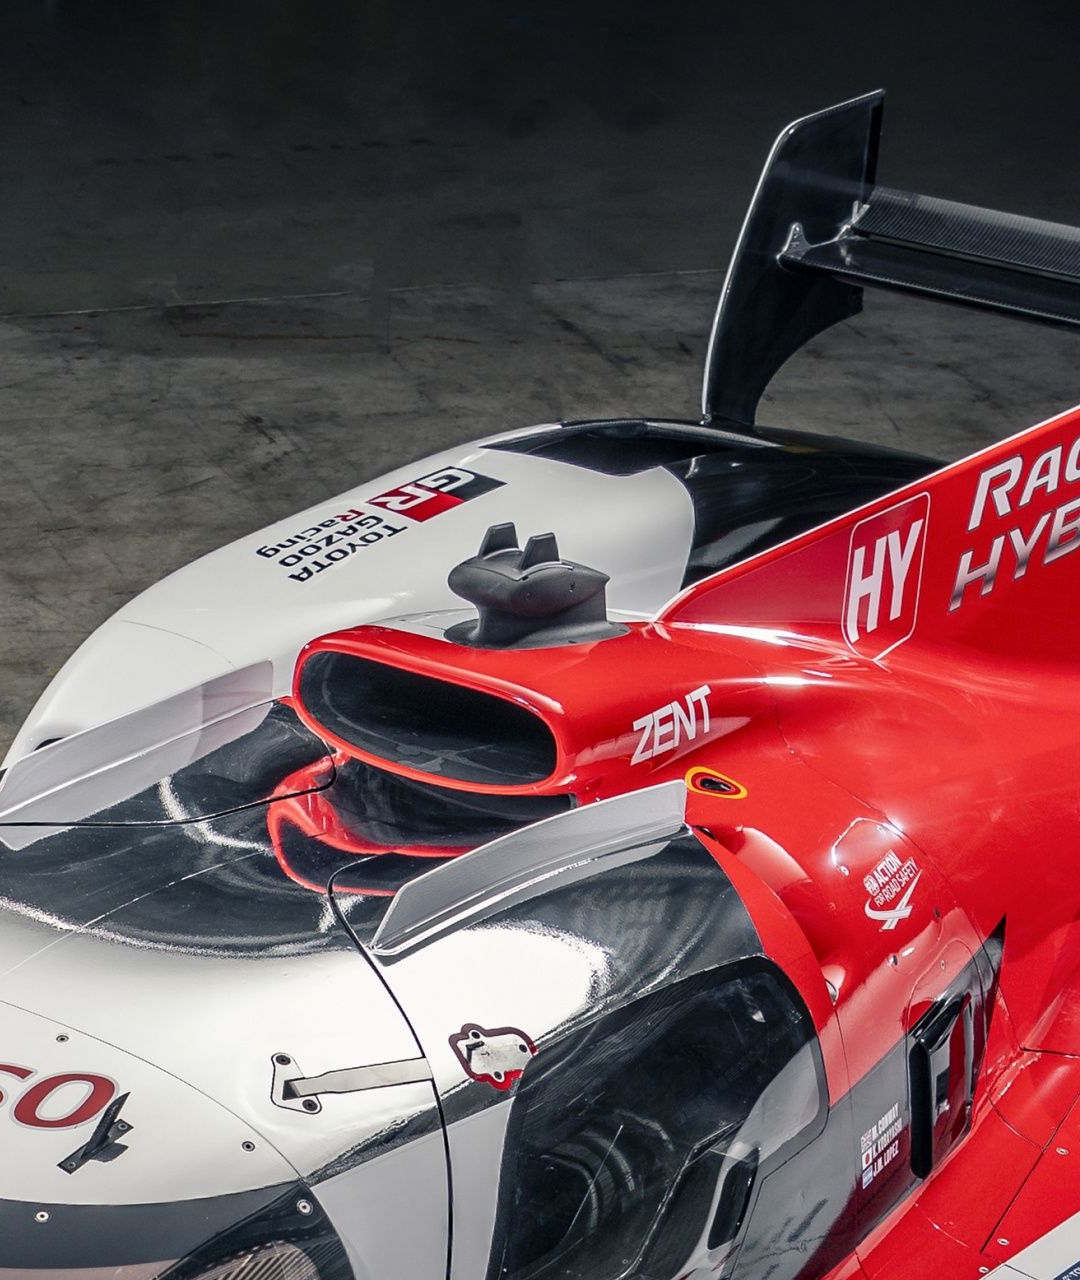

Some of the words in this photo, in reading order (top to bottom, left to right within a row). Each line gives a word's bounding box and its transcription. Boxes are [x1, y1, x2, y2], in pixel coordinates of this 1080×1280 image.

[370, 467, 475, 511] GR
[255, 509, 366, 558] Racing
[278, 515, 384, 567] GAZOO
[288, 524, 408, 582] TOYOTA
[846, 518, 924, 643] HY
[630, 685, 712, 766] ZENT
[873, 849, 902, 887] ACTION
